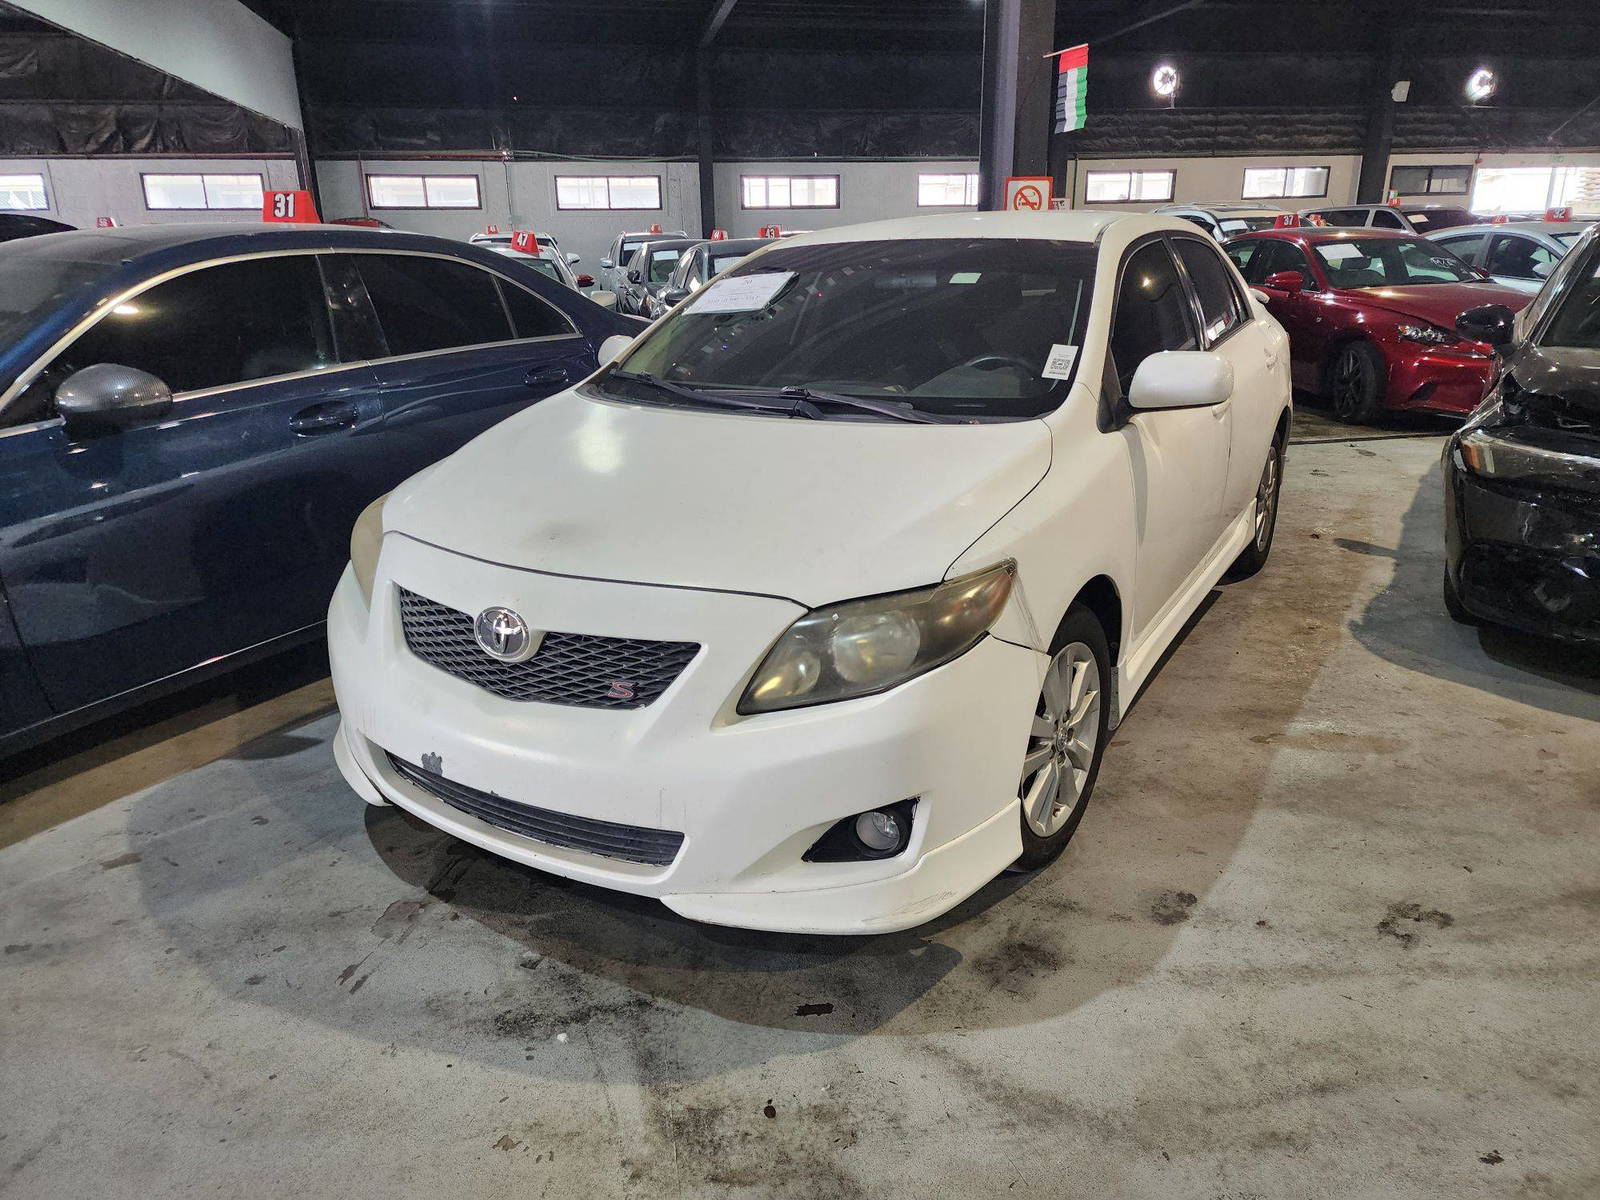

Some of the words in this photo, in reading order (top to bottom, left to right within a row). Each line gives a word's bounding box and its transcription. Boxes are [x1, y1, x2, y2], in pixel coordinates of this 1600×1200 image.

[273, 192, 296, 218] 31
[1283, 215, 1294, 226] 37
[517, 232, 528, 247] 47
[765, 228, 775, 239] 43
[607, 680, 635, 700] S
